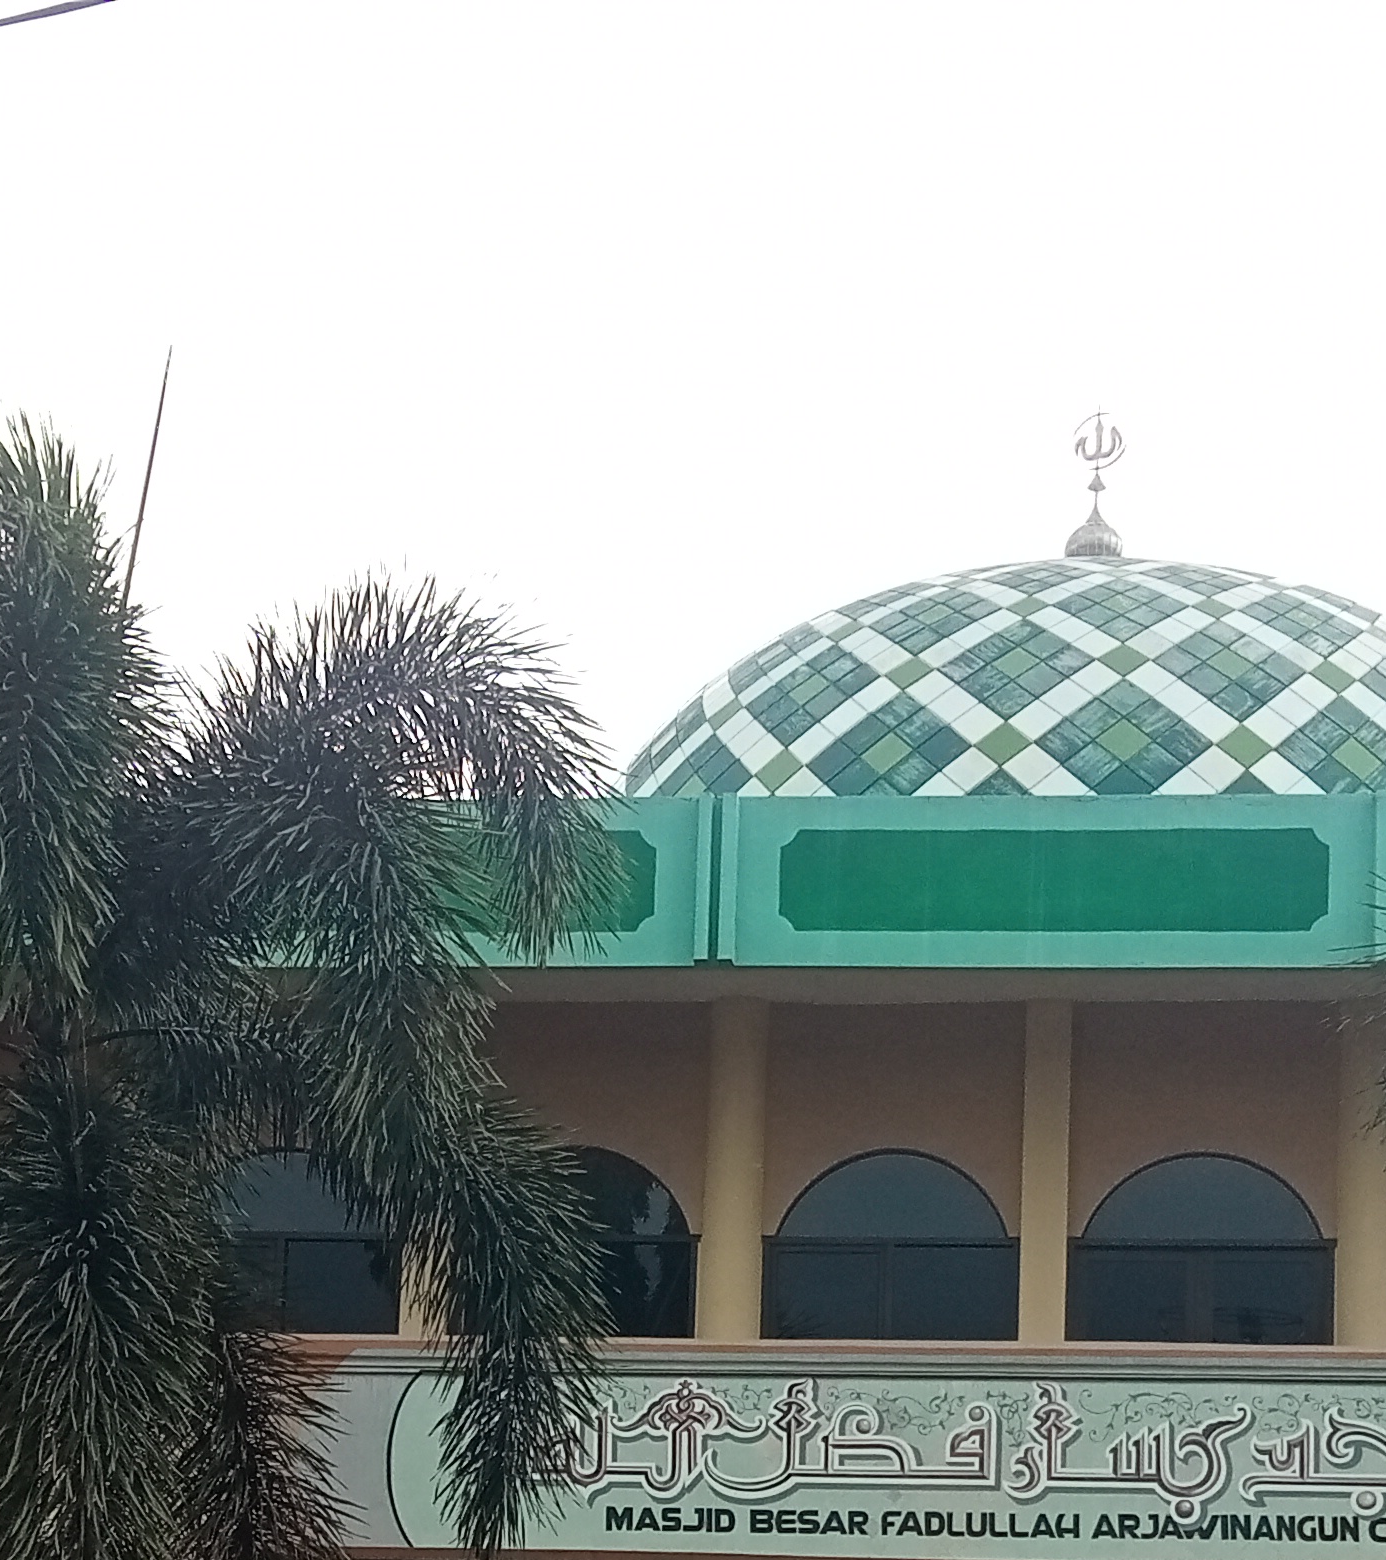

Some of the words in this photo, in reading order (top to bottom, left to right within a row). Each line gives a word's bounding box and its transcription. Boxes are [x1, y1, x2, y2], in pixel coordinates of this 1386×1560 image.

[604, 1505, 736, 1534] MASJID
[749, 1508, 869, 1537] BESAR
[880, 1509, 1081, 1540] FADLULLAH
[1091, 1512, 1360, 1543] ARJAWINANGUN
